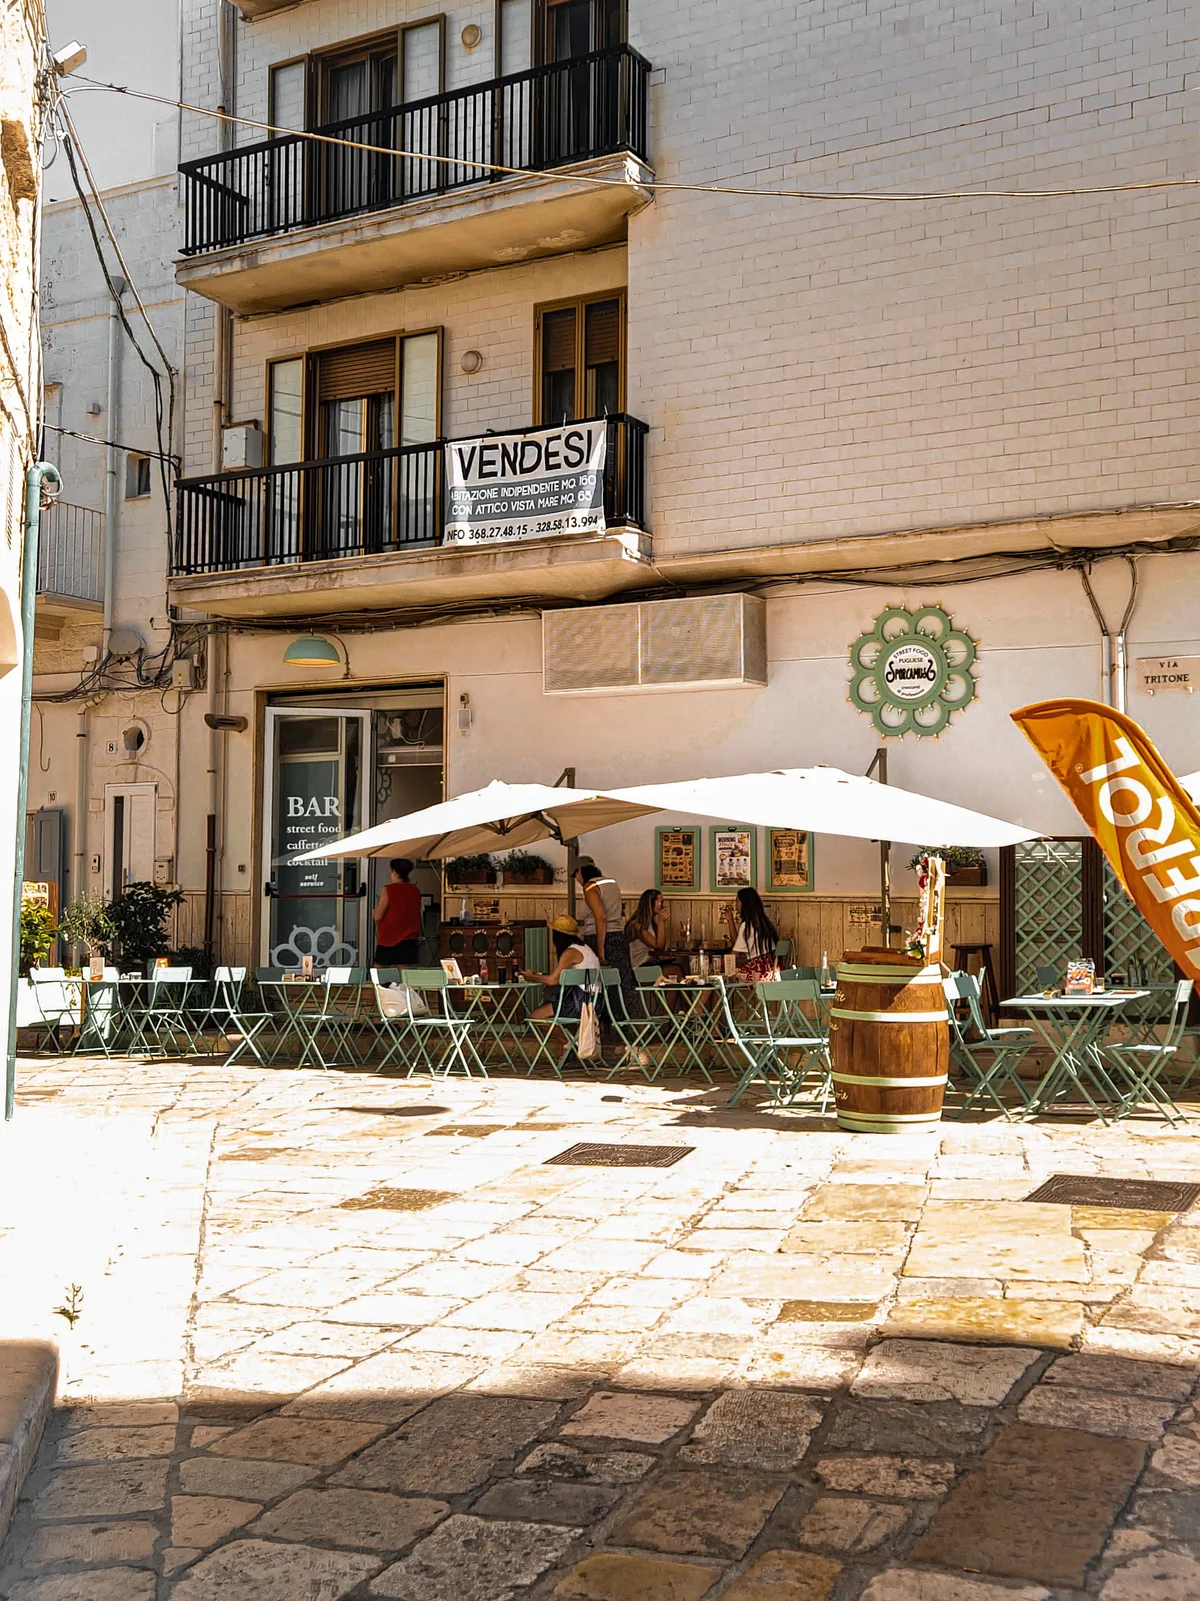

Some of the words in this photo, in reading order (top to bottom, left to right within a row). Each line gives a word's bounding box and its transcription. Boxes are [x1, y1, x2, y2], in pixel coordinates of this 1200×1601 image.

[458, 429, 592, 480] VENDESI
[501, 480, 559, 497] INDIPENDENTE
[579, 474, 597, 486] 160
[452, 504, 473, 516] CON
[475, 501, 509, 515] ATTICO
[511, 500, 535, 511] VISTA
[538, 497, 559, 509] MARE
[577, 490, 593, 502] 65
[468, 524, 528, 540] 368.27.48.15
[536, 515, 598, 533] 328.58.13.994
[894, 648, 911, 658] STREET
[1144, 673, 1190, 684] TRITONE
[108, 743, 114, 752] 8
[49, 793, 56, 801] 10
[287, 796, 342, 817] BAR
[286, 823, 315, 834] street
[318, 822, 342, 834] food
[286, 839, 333, 850] caffette
[1079, 736, 1200, 969] PEROL
[304, 873, 318, 881] self
